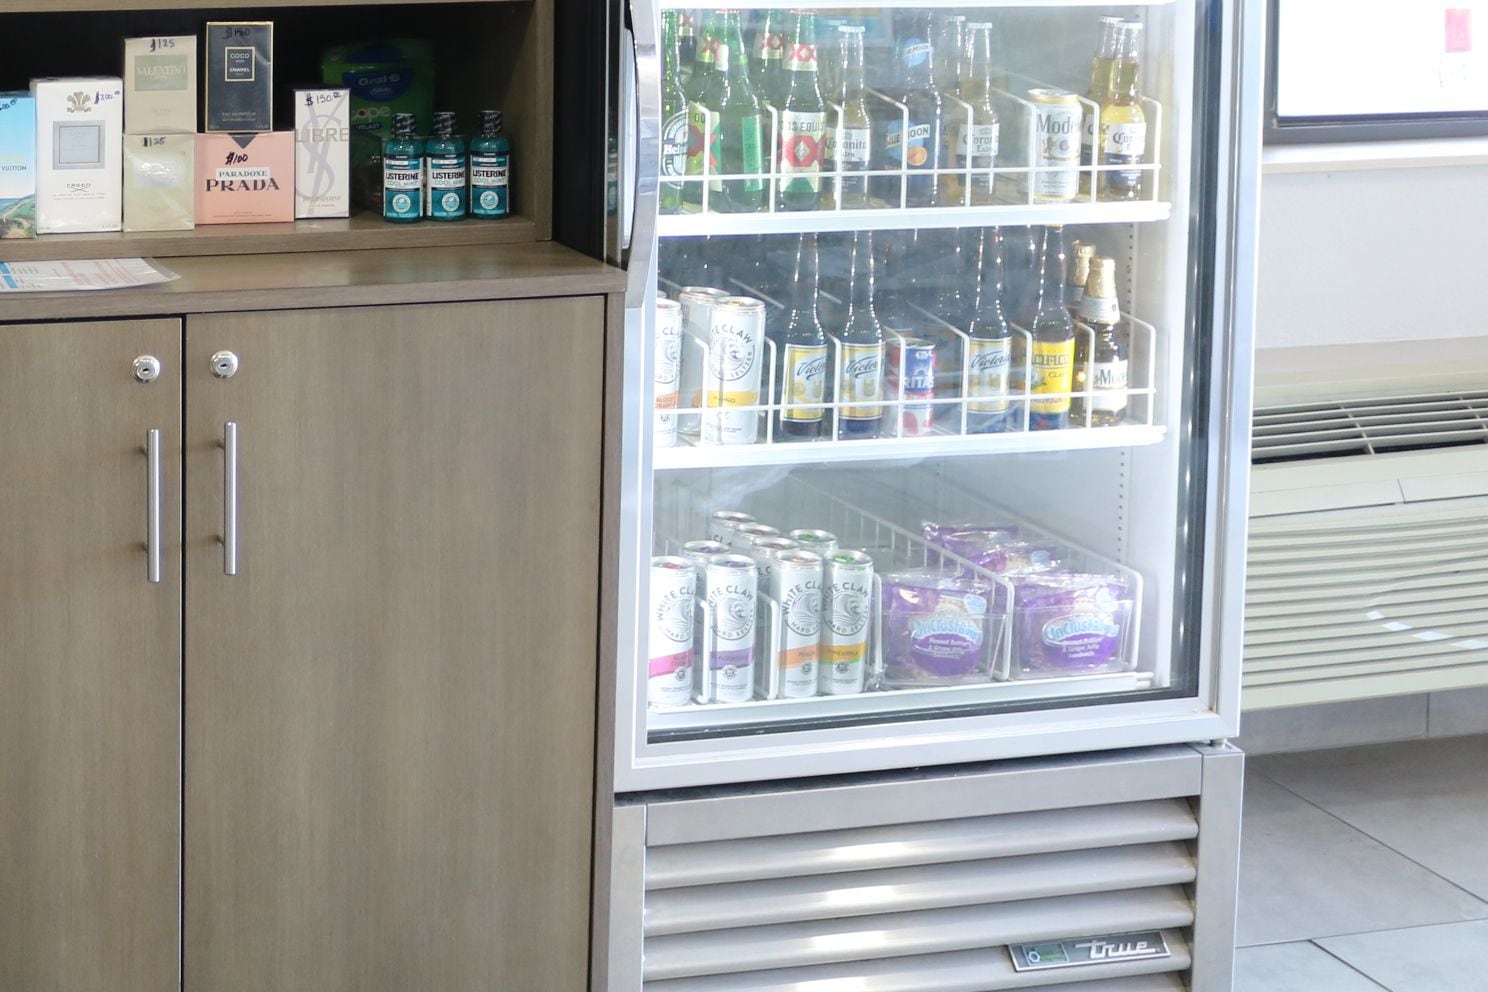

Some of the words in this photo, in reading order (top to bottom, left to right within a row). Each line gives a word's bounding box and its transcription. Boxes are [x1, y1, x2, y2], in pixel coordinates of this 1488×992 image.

[296, 128, 349, 143] LIBRE
[226, 152, 248, 164] $100
[206, 179, 280, 191] PRADA
[722, 324, 753, 344] CLAW
[726, 585, 753, 601] CLAW
[841, 582, 869, 598] CLAW
[657, 590, 677, 621] WHITE
[783, 584, 802, 615] WHITE
[1075, 940, 1155, 959] true
